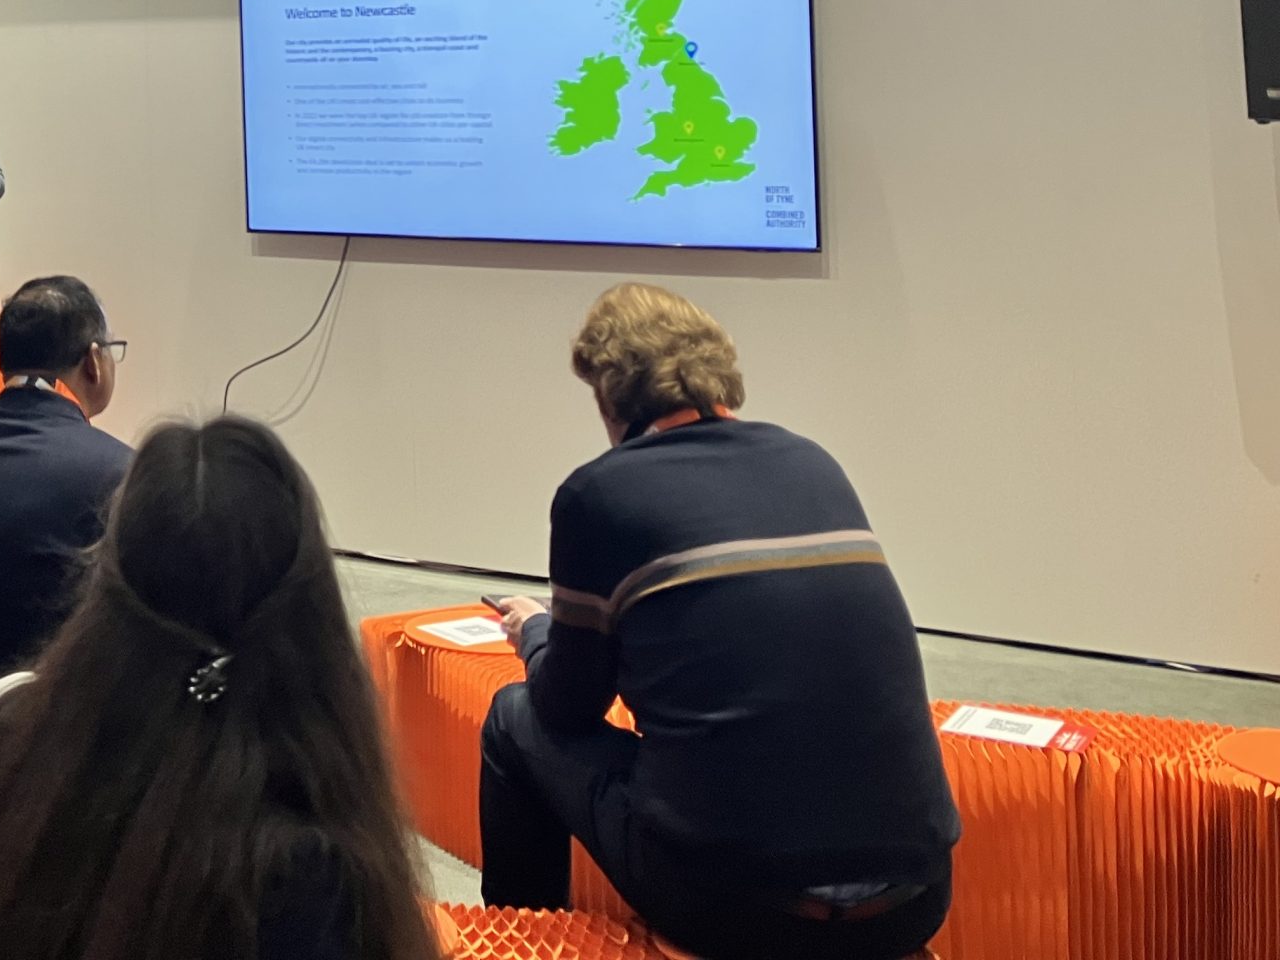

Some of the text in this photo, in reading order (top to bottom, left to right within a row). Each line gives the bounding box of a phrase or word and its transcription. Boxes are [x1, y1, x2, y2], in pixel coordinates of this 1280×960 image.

[285, 3, 416, 19] Welcome to Newcastle
